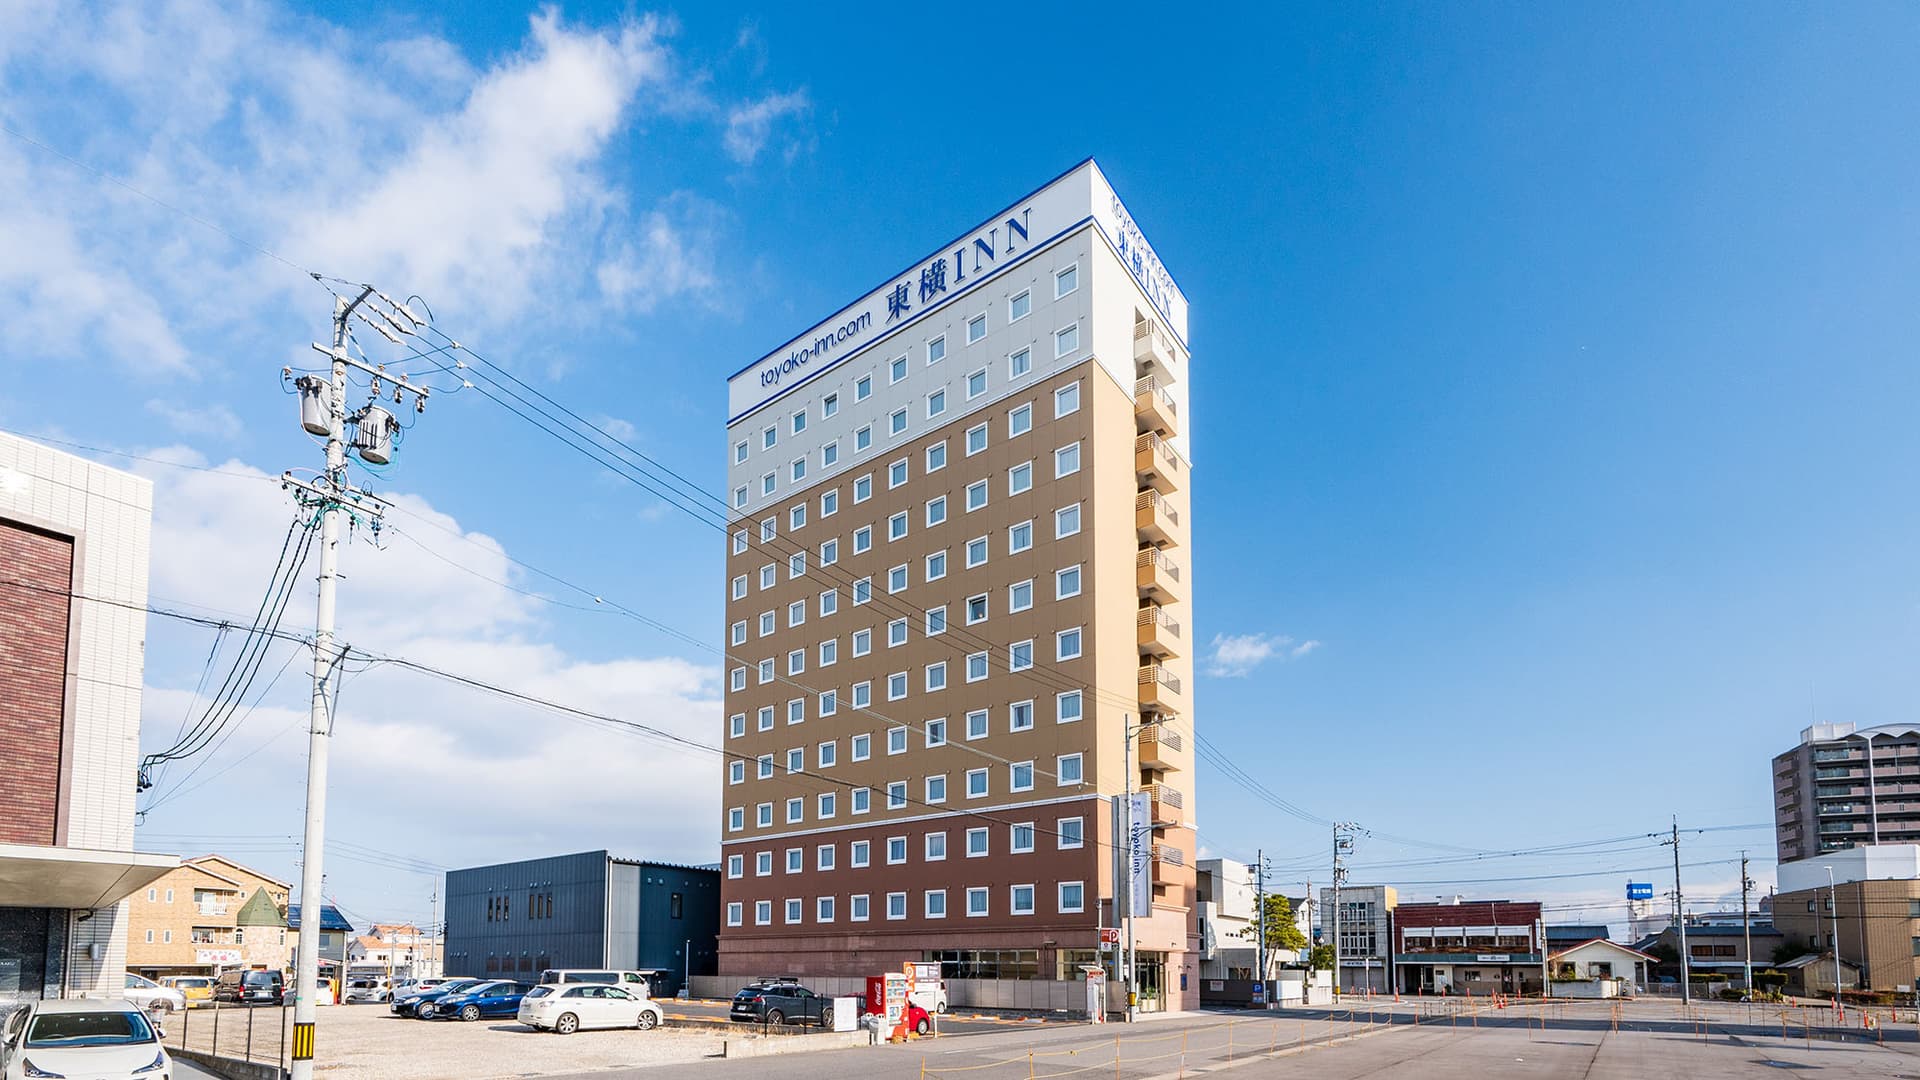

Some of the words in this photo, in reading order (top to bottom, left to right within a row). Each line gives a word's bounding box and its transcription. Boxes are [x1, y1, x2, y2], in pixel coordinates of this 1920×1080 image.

[760, 309, 872, 387] toyoko-inn.com
[885, 207, 1033, 324] 東横INN
[1131, 821, 1142, 856] toyoko
